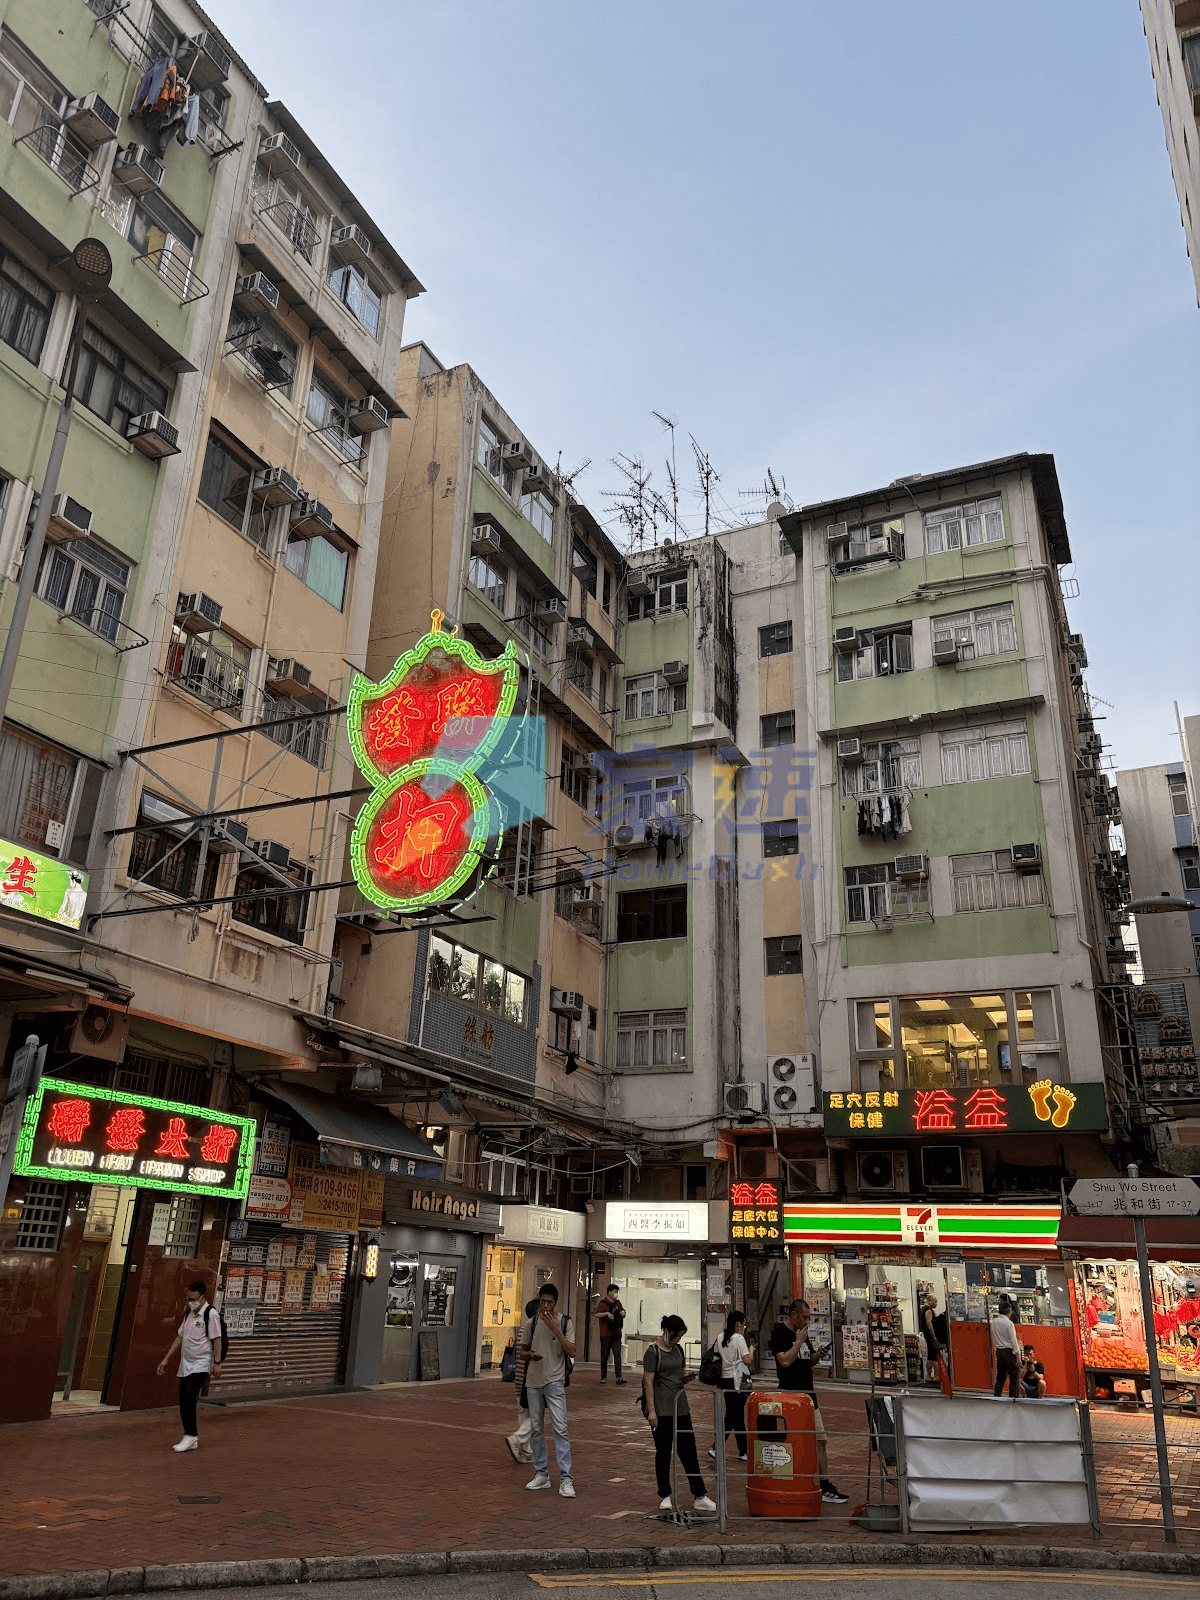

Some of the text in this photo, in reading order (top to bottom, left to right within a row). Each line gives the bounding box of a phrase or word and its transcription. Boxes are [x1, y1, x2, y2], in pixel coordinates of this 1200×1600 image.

[3, 855, 37, 898] 生
[829, 1090, 900, 1109] 足穴反射
[849, 1111, 884, 1129] 保健
[188, 1166, 226, 1184] SHOP
[313, 1177, 357, 1200] 8109-9166
[1092, 1182, 1177, 1192] Shiu Wo Street
[411, 1190, 442, 1212] Hair
[443, 1194, 481, 1220] Angel
[1113, 1198, 1161, 1211] 兆和街
[732, 1210, 779, 1223] 足底穴位
[732, 1225, 779, 1239] 保健中心
